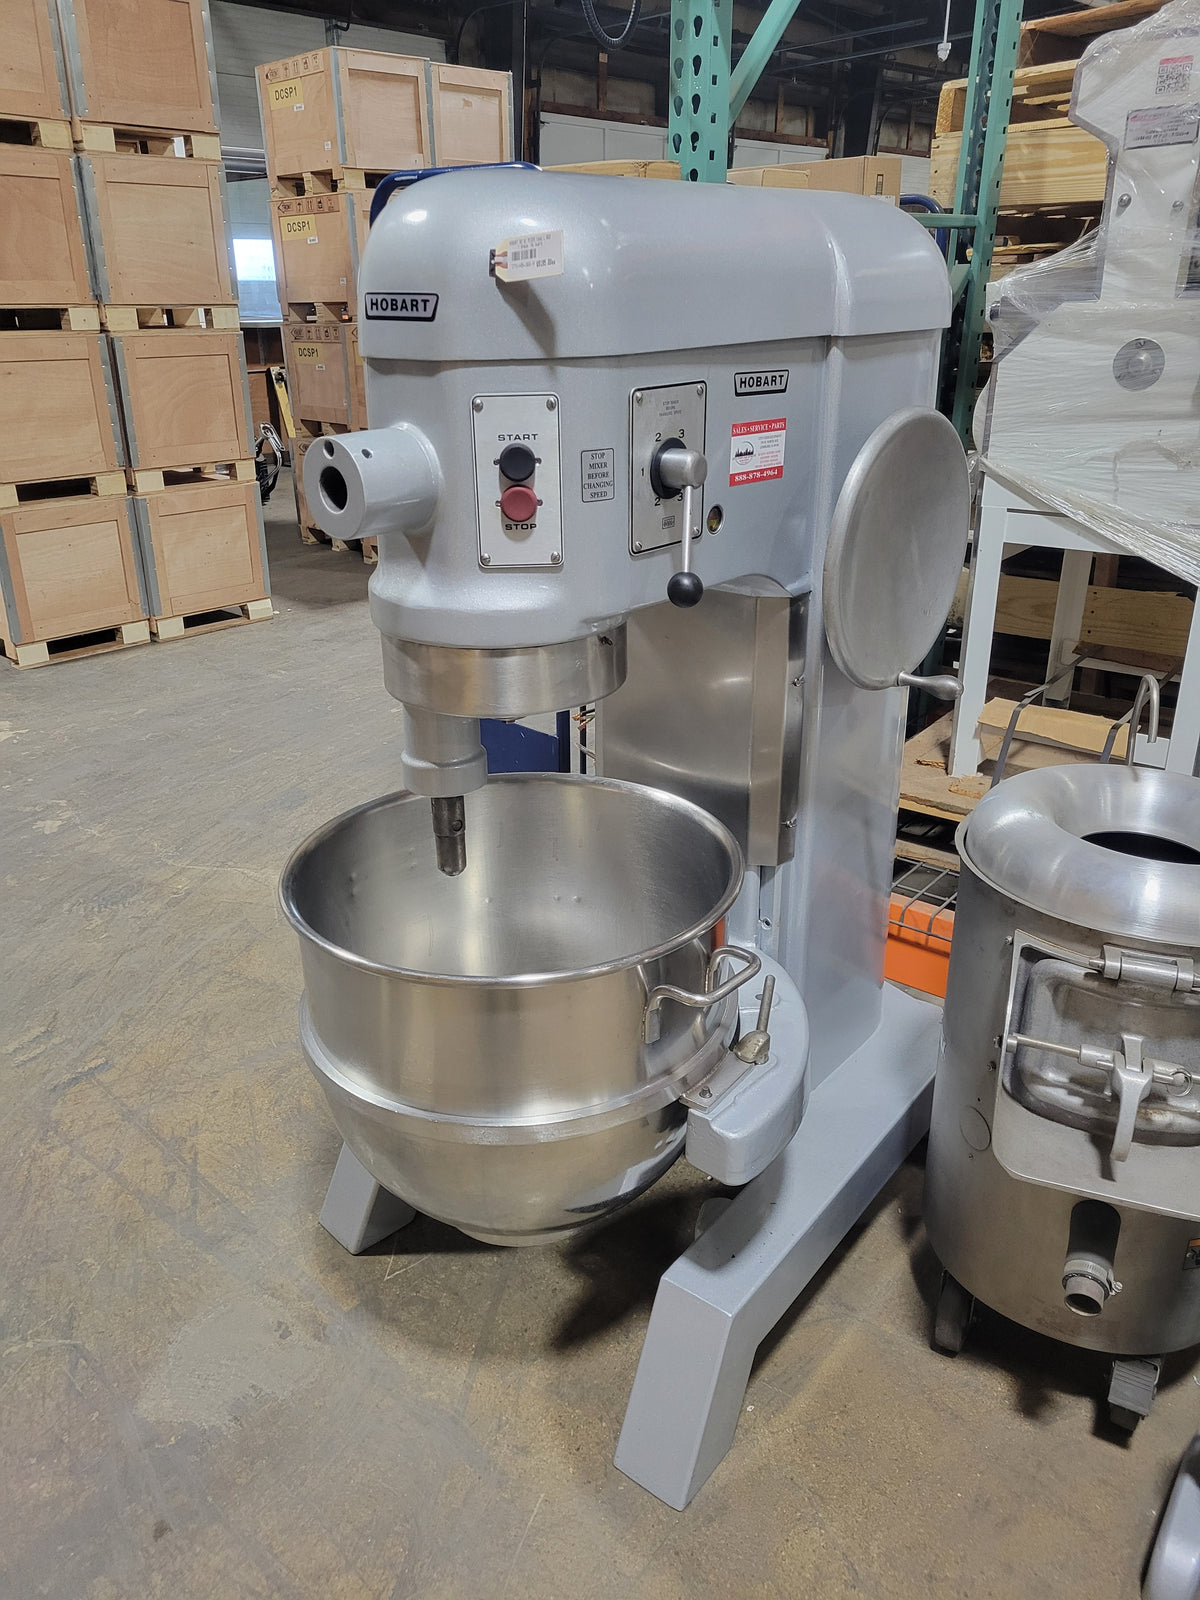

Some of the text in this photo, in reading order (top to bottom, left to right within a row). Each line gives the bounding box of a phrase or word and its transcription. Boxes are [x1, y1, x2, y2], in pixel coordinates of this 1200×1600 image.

[274, 86, 298, 101] DCSP1
[286, 220, 311, 233] DCSP1
[370, 297, 430, 312] HOBART
[298, 347, 319, 358] DCSP1
[740, 375, 784, 388] HOBART
[733, 421, 785, 434] SALES SERVICE PARTS
[498, 433, 539, 442] START
[655, 428, 685, 442] 2 3
[590, 452, 606, 460] STOP
[589, 461, 608, 470] MIXER
[587, 471, 610, 480] BEFORE
[641, 467, 645, 477] 1
[735, 469, 777, 482] 888-878-4964
[583, 480, 614, 490] CHANGING
[590, 490, 608, 499] SPEED
[654, 491, 684, 507] 2 3
[505, 523, 537, 531] STOP
